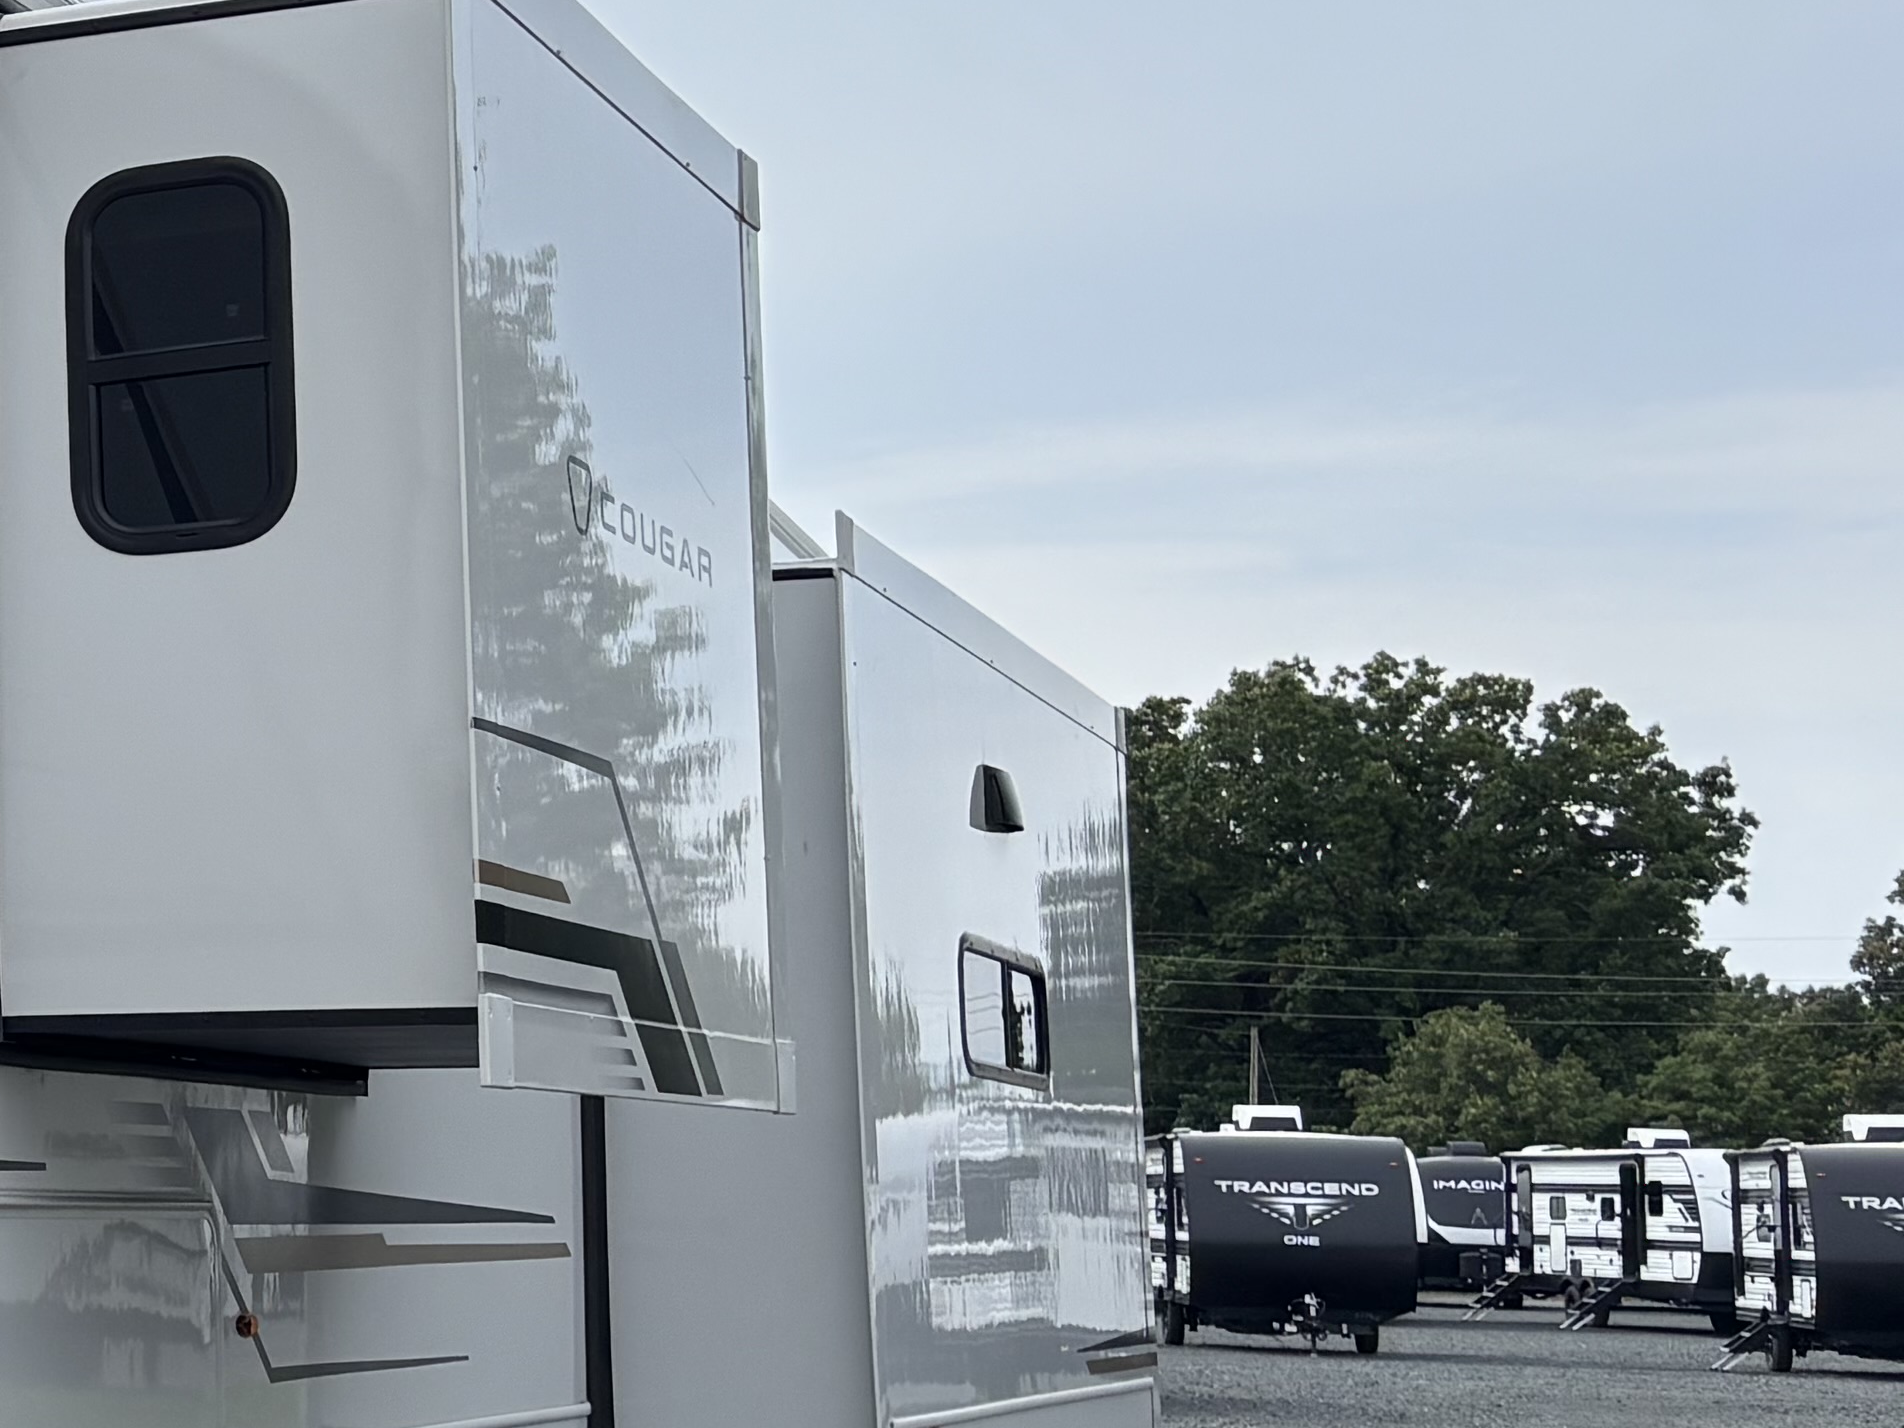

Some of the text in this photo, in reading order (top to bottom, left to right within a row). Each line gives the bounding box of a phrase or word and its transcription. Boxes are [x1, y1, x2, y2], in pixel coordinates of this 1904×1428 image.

[600, 491, 712, 588] COUGAR
[1214, 1180, 1379, 1196] TRANSCEND
[1433, 1179, 1505, 1191] IMAGIN
[1840, 1196, 1904, 1210] TRA
[1283, 1234, 1320, 1247] ONE
